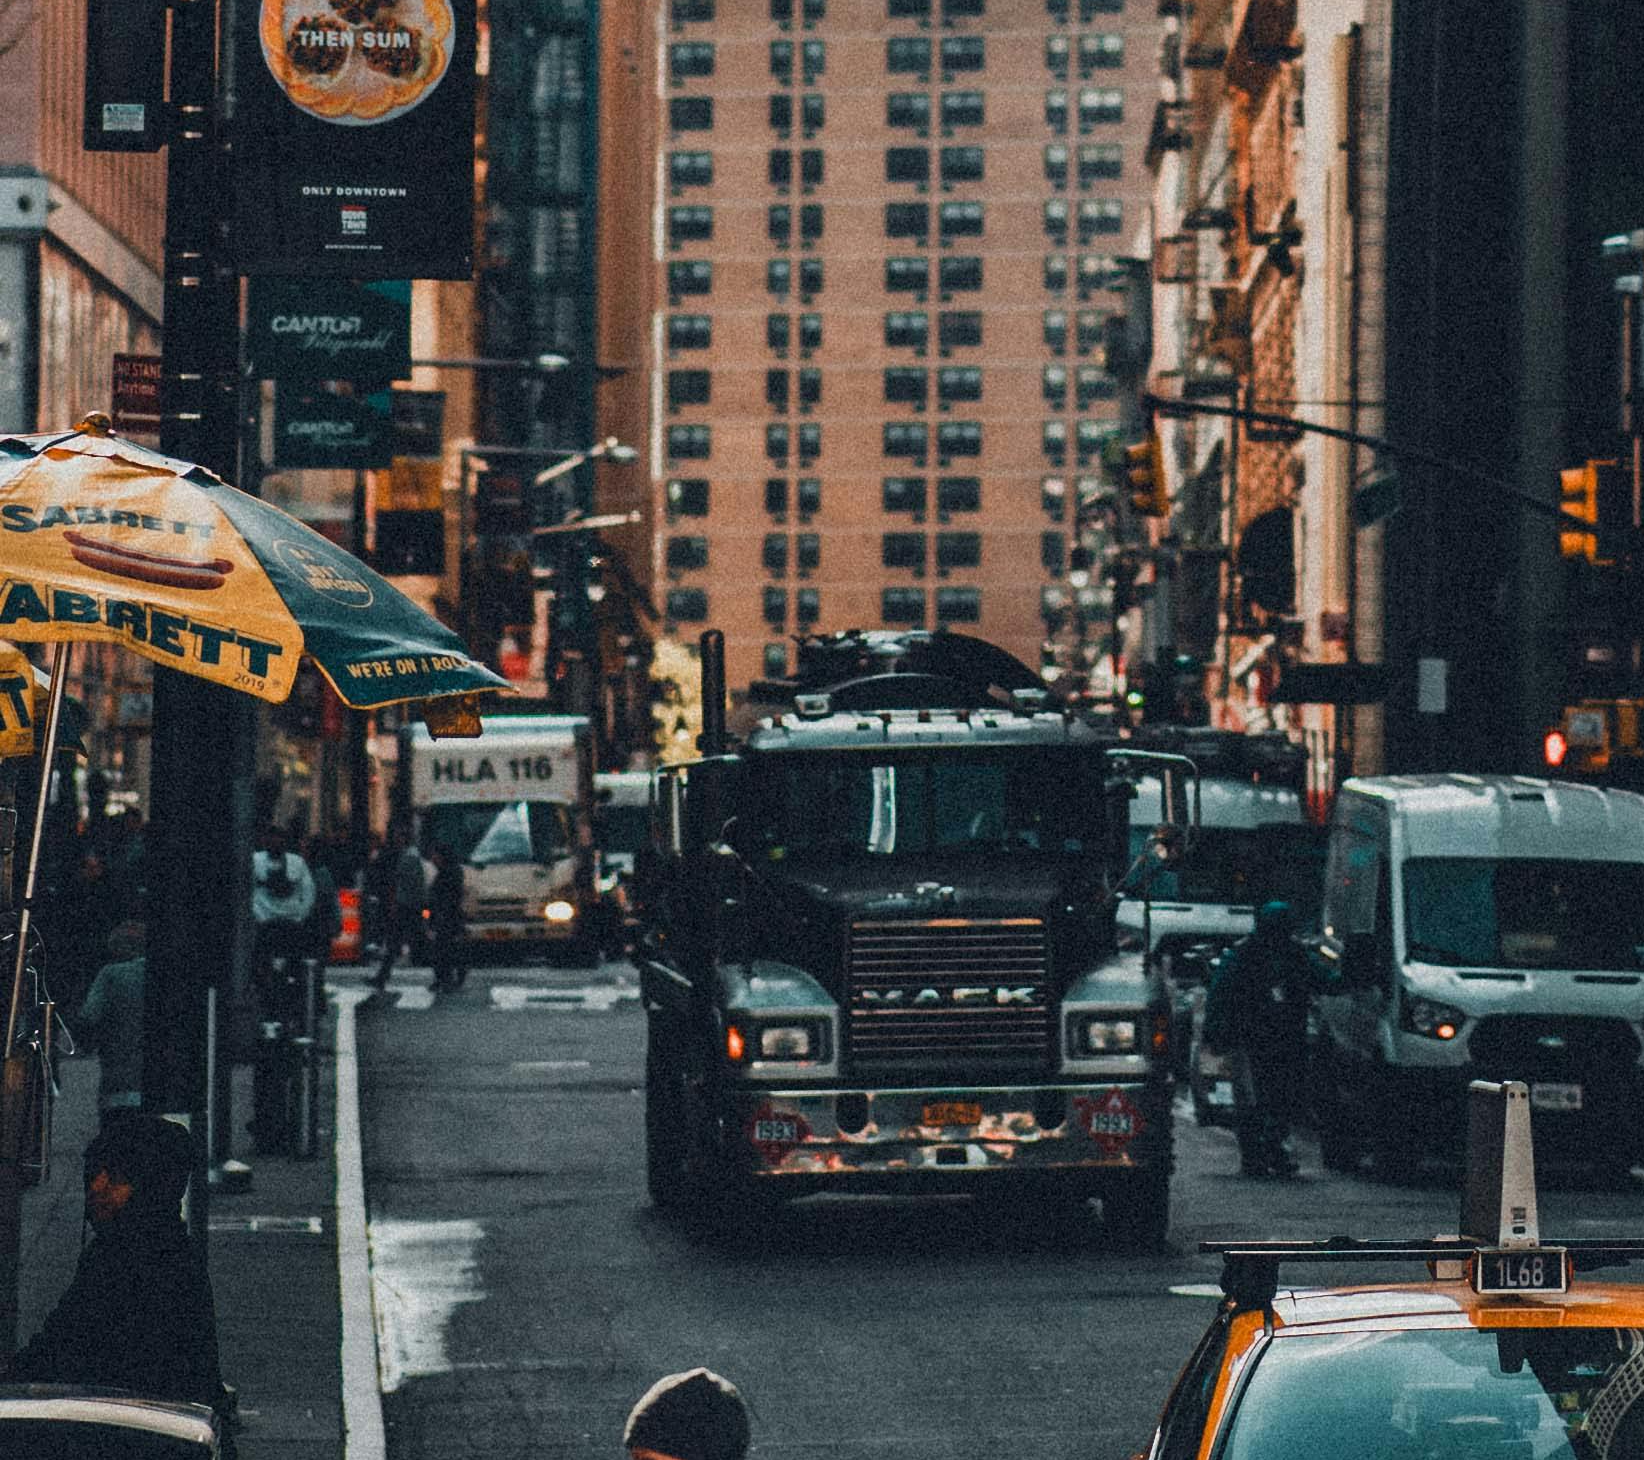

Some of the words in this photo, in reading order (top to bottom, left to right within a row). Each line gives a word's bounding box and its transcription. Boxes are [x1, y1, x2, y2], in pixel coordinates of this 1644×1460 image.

[299, 31, 355, 46] THEN
[362, 32, 410, 48] SUM
[302, 186, 332, 196] ONLY
[336, 187, 407, 197] DOWNTOWN
[1, 504, 216, 539] SABRETT
[346, 661, 394, 679] WE'RE
[396, 658, 417, 675] ON
[233, 673, 266, 693] 2019
[433, 758, 497, 782] HLA
[859, 986, 1037, 1005] MACK
[1495, 1257, 1544, 1287] 1L68
